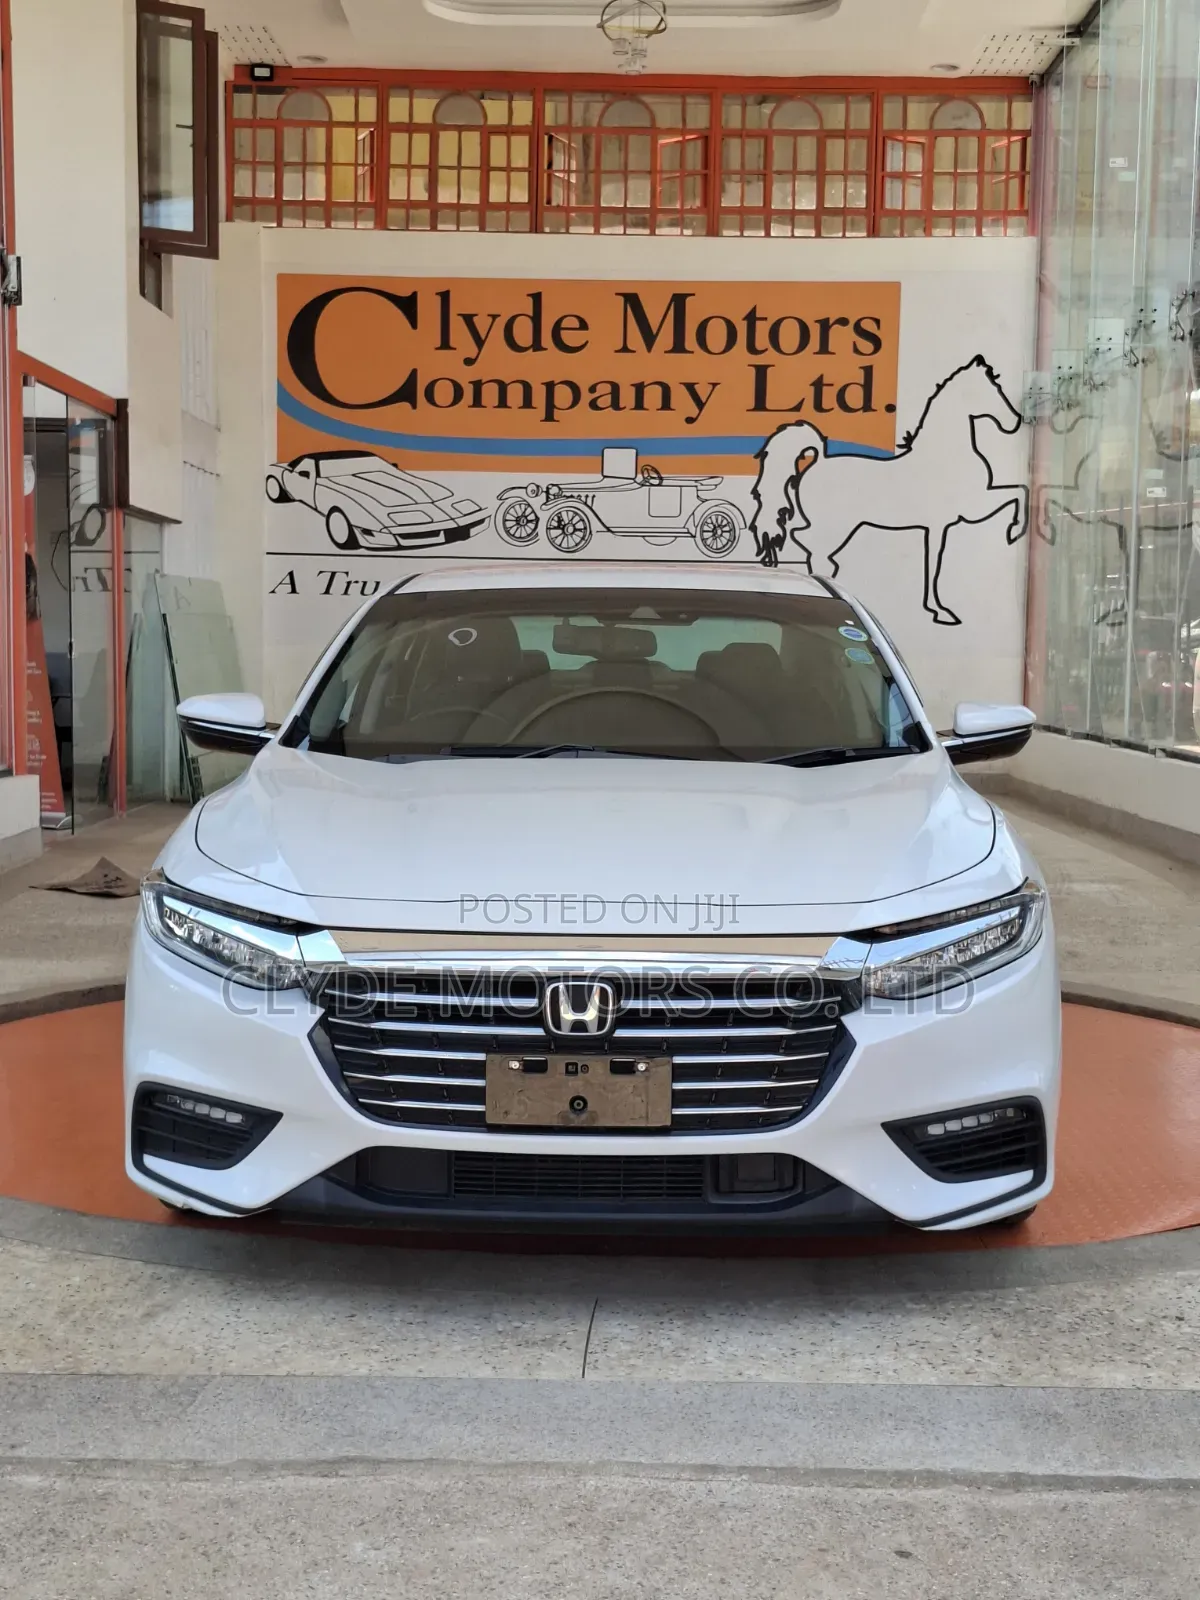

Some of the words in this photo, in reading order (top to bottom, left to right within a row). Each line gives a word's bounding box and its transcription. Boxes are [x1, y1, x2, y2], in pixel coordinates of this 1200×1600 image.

[614, 292, 883, 356] Motors
[746, 363, 897, 414] Ltd.
[268, 569, 300, 595] A
